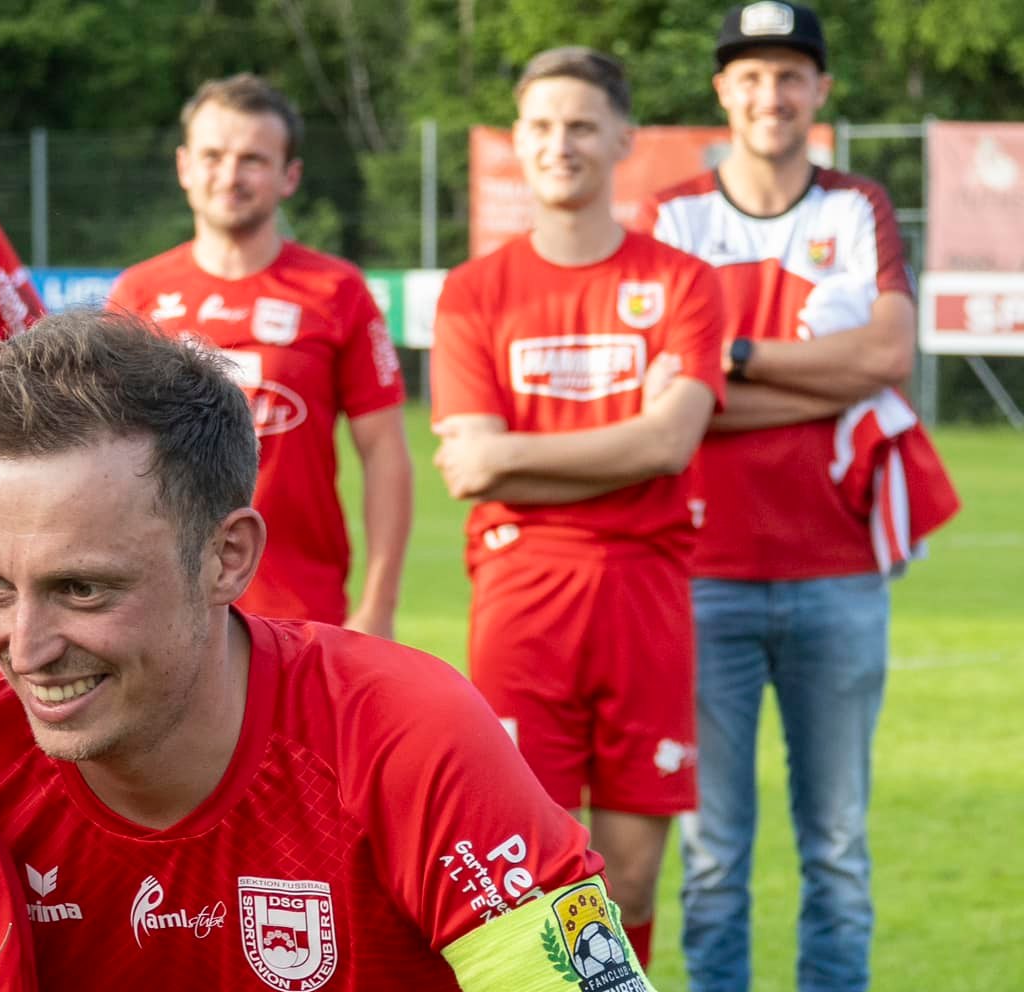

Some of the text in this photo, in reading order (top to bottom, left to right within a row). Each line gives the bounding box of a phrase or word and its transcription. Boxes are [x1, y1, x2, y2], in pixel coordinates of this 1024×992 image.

[269, 896, 305, 908] DSG
[242, 895, 334, 990] SPORTUNION ALTENBERG
